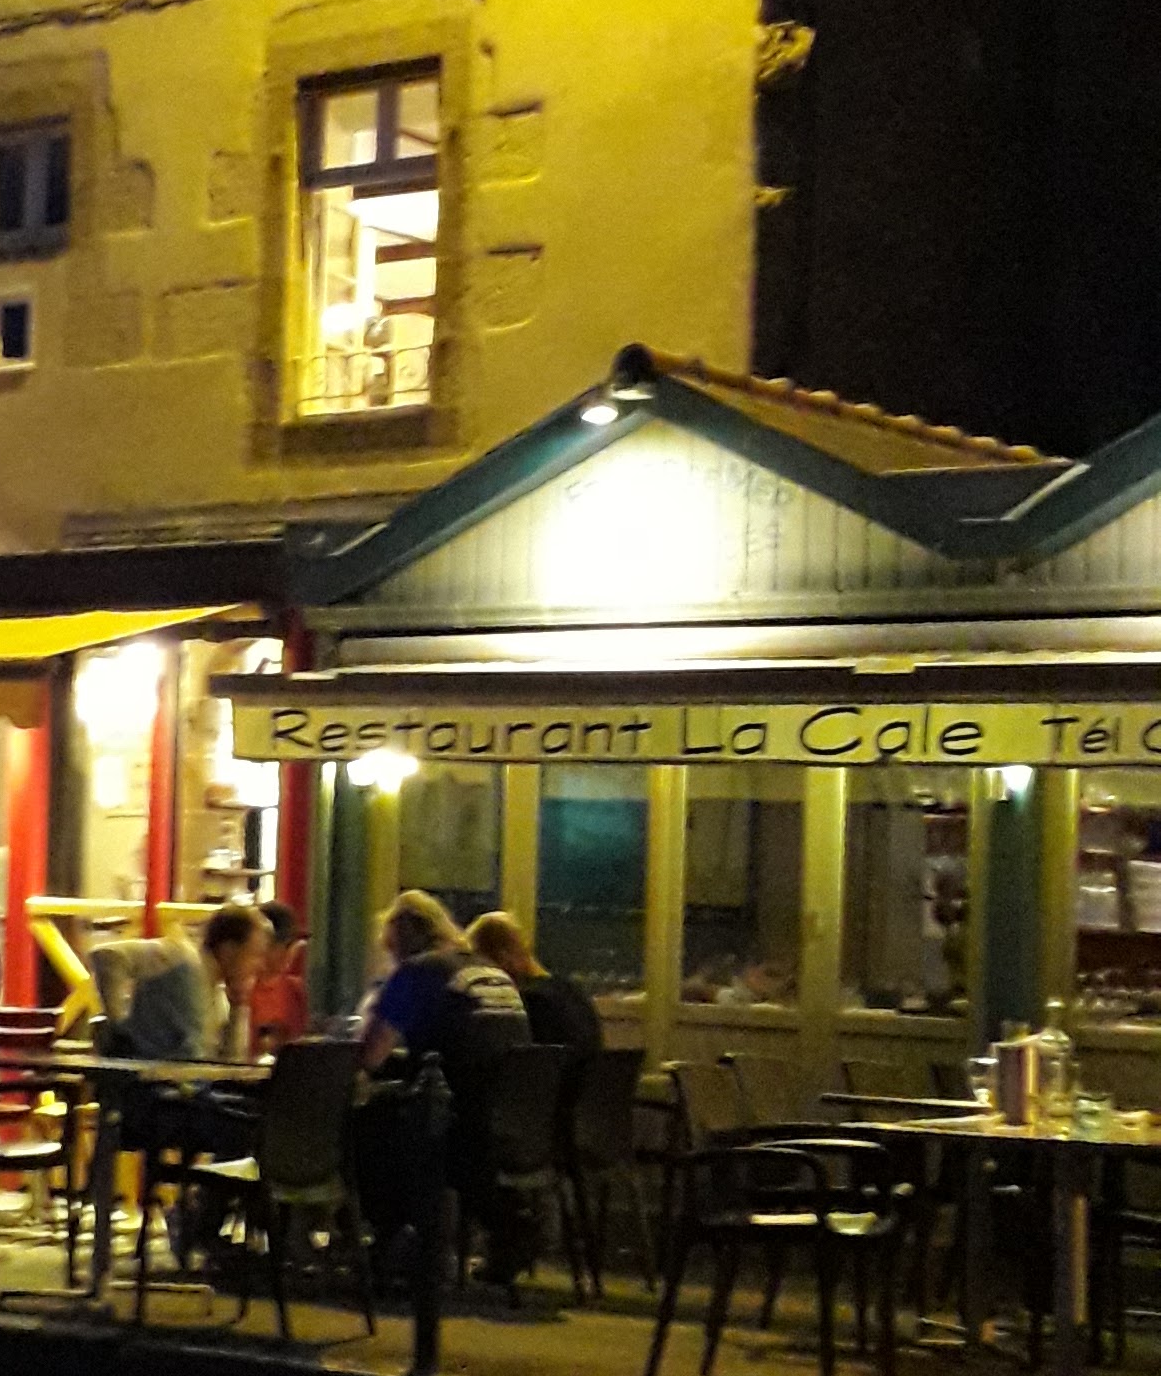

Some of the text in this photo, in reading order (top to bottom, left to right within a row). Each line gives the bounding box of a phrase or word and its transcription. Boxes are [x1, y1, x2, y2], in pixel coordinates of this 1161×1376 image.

[270, 706, 652, 754] Restaurant
[682, 704, 766, 756] La
[800, 704, 983, 756] Cale
[1040, 714, 1121, 755] Tél
